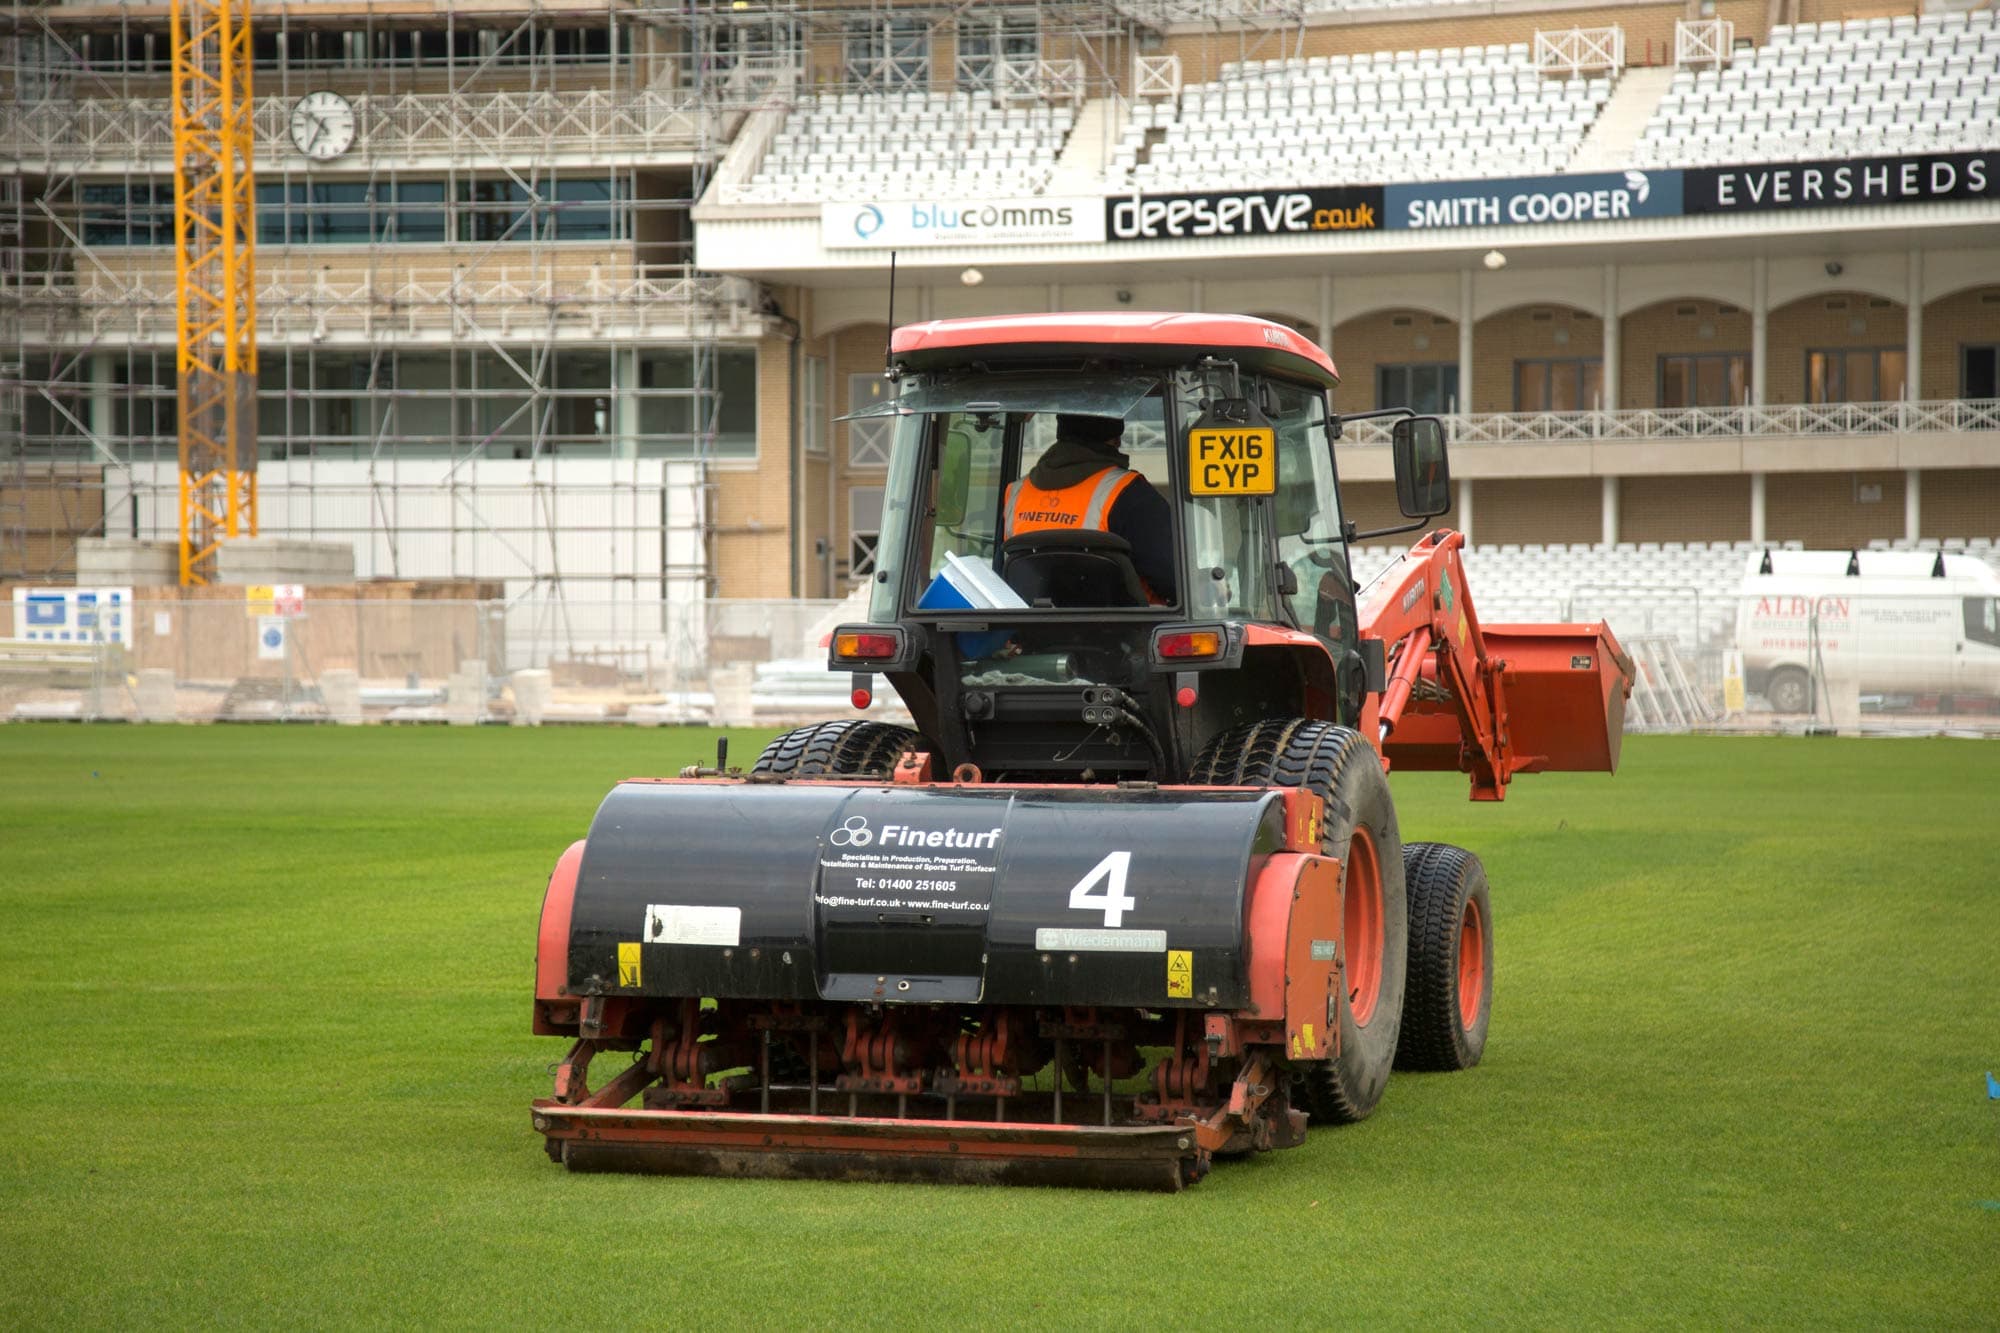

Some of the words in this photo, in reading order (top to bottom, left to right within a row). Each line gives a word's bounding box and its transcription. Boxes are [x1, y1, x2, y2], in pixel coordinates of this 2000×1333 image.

[1717, 160, 1987, 206] EVERSHEDS
[911, 203, 1073, 229] blucomms
[1408, 196, 1499, 228] SMITH
[1508, 190, 1631, 225] COOPER
[1199, 435, 1263, 460] FX16
[1203, 463, 1259, 488] CYP
[879, 824, 1001, 849] Fineturf
[841, 853, 880, 863] Specialists
[890, 855, 932, 864] Production,
[933, 856, 978, 865] Preparation,
[868, 861, 913, 870] Maintenance
[914, 862, 923, 870] of
[923, 863, 948, 872] Sports
[949, 863, 964, 872] Turf
[855, 878, 875, 888] Tel:
[878, 878, 913, 890] 01400
[914, 880, 957, 891] 251605
[1068, 850, 1135, 927] 4
[907, 900, 990, 911] www.fine-turf.co.u
[1063, 933, 1162, 948] Wiedenmann
